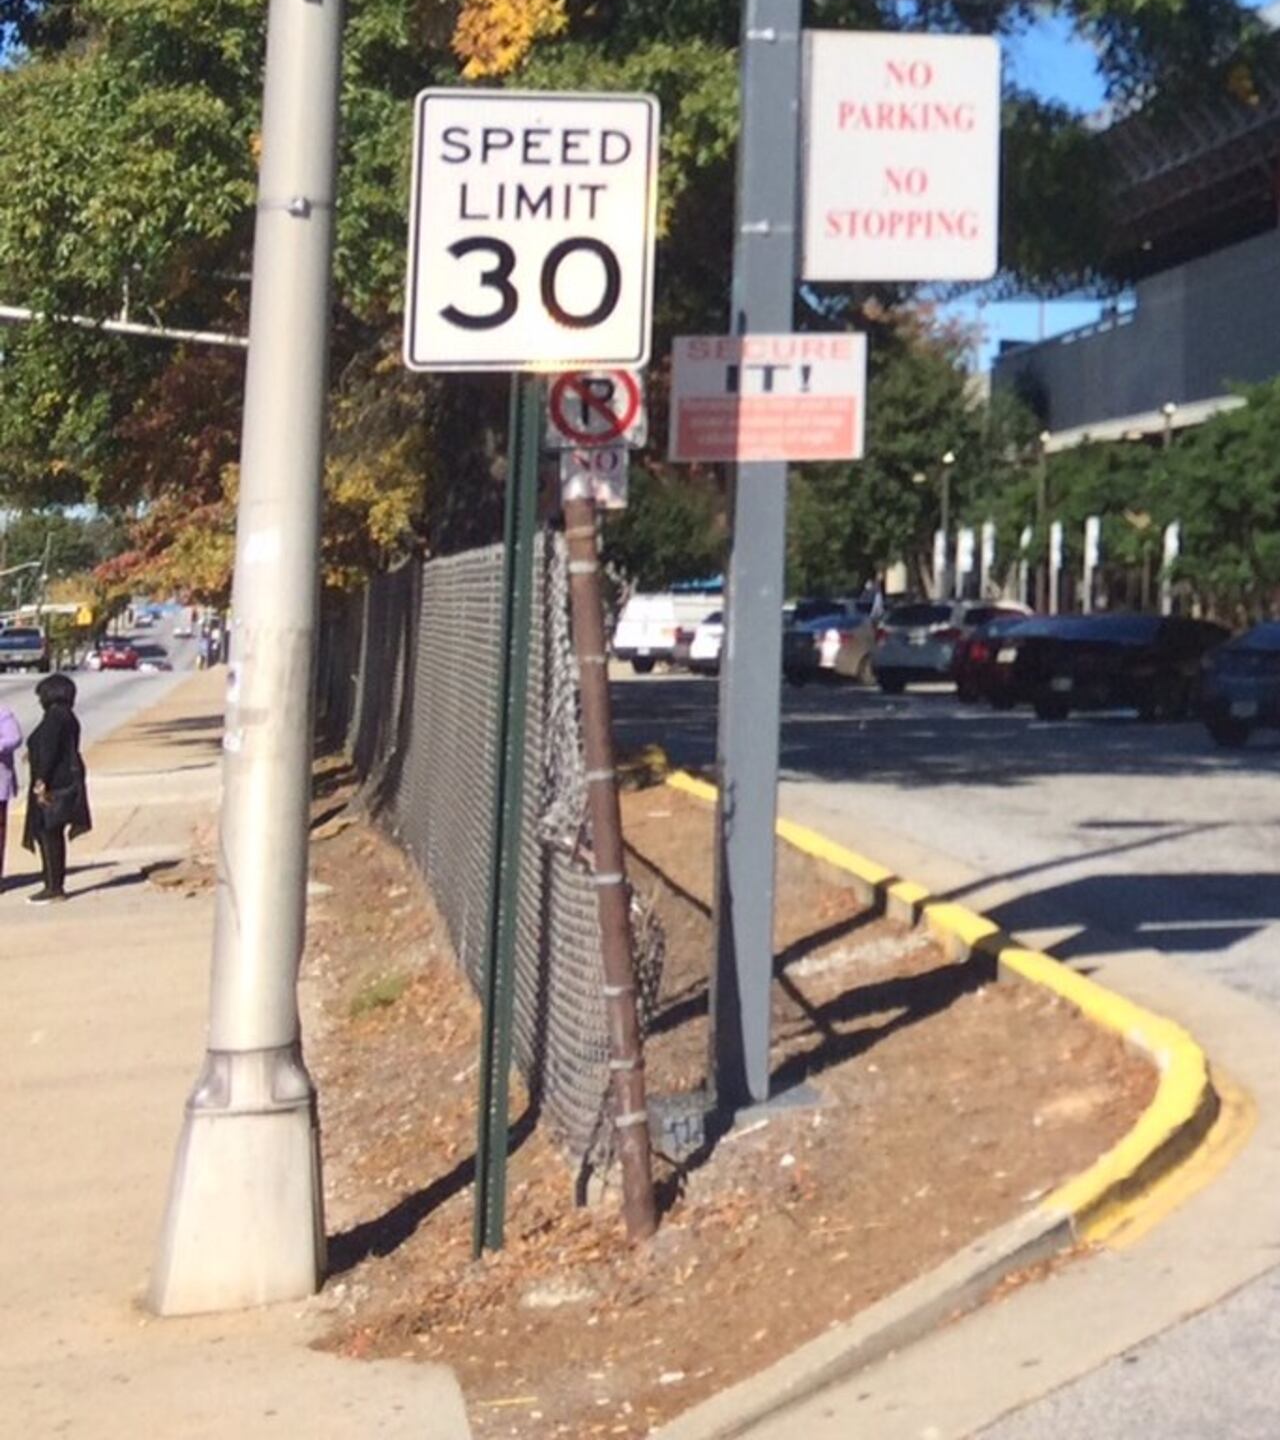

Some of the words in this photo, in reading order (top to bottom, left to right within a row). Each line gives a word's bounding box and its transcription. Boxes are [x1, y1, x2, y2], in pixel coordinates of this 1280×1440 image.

[886, 60, 933, 88] NO
[837, 101, 975, 132] PARKING
[440, 127, 632, 165] SPEED
[885, 167, 928, 196] NO
[460, 183, 607, 220] LIMIT
[825, 210, 979, 239] STOPPING
[439, 236, 621, 331] 30
[687, 340, 848, 360] SECURE
[726, 364, 812, 393] IT!
